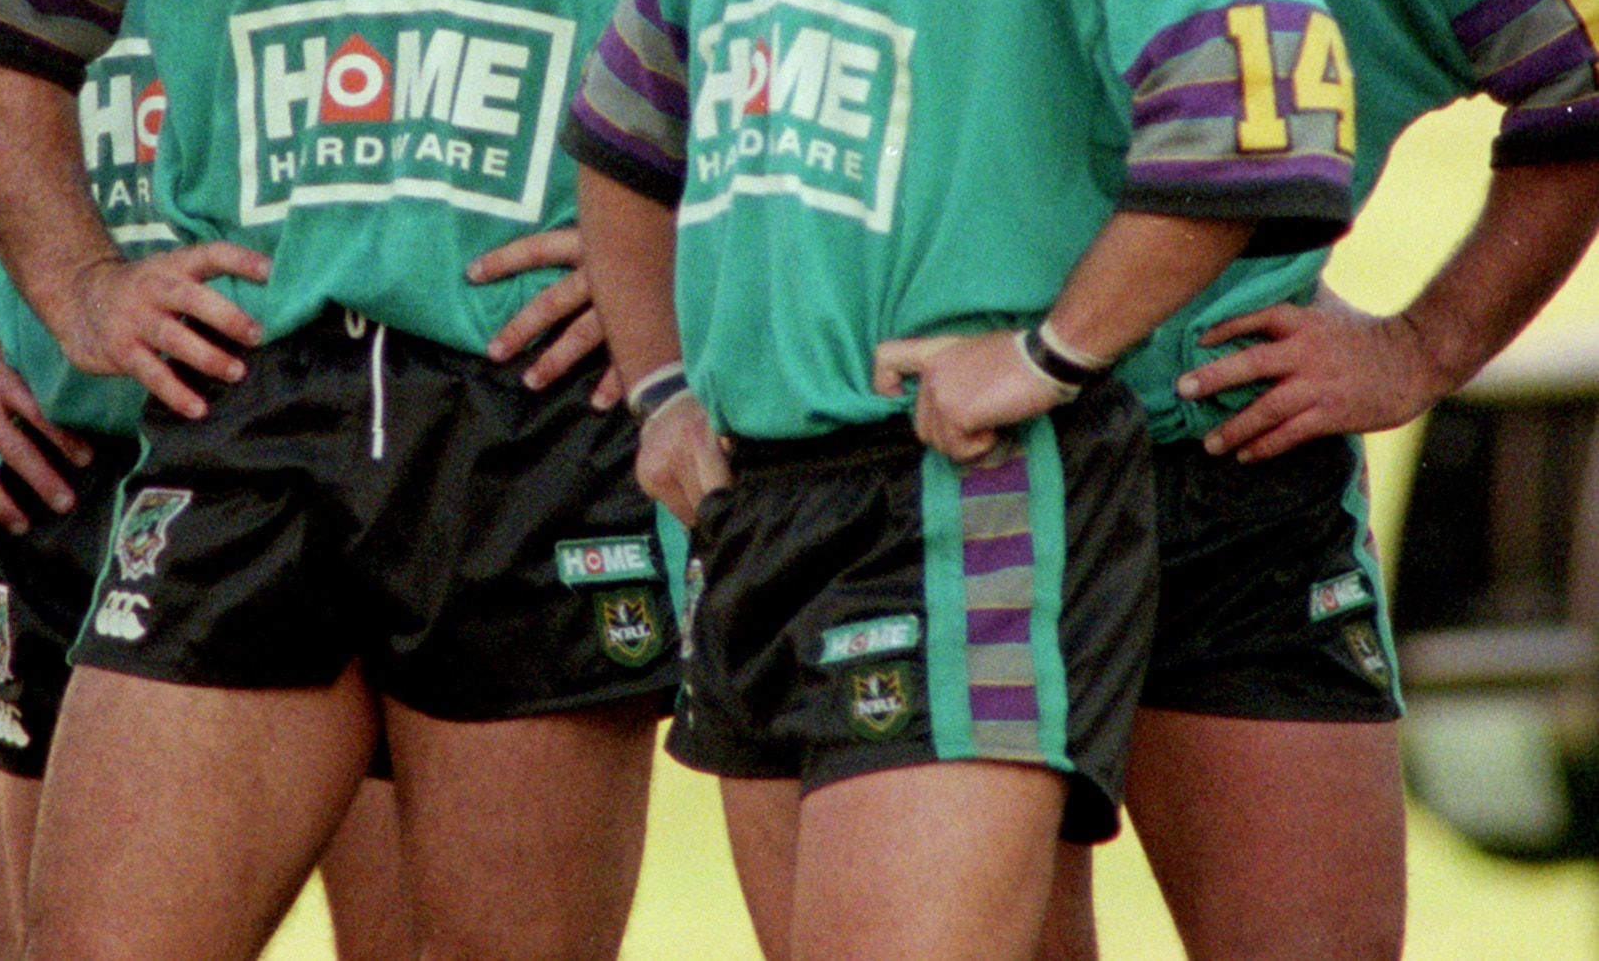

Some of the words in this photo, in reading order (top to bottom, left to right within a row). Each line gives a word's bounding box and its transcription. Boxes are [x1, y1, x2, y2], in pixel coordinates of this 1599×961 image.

[264, 28, 530, 139] HOME
[1228, 9, 1357, 153] 14
[79, 74, 166, 171] HO
[269, 132, 509, 183] HRDARE
[696, 126, 864, 182] HDARE
[562, 543, 646, 576] HOME
[607, 624, 651, 642] NRL
